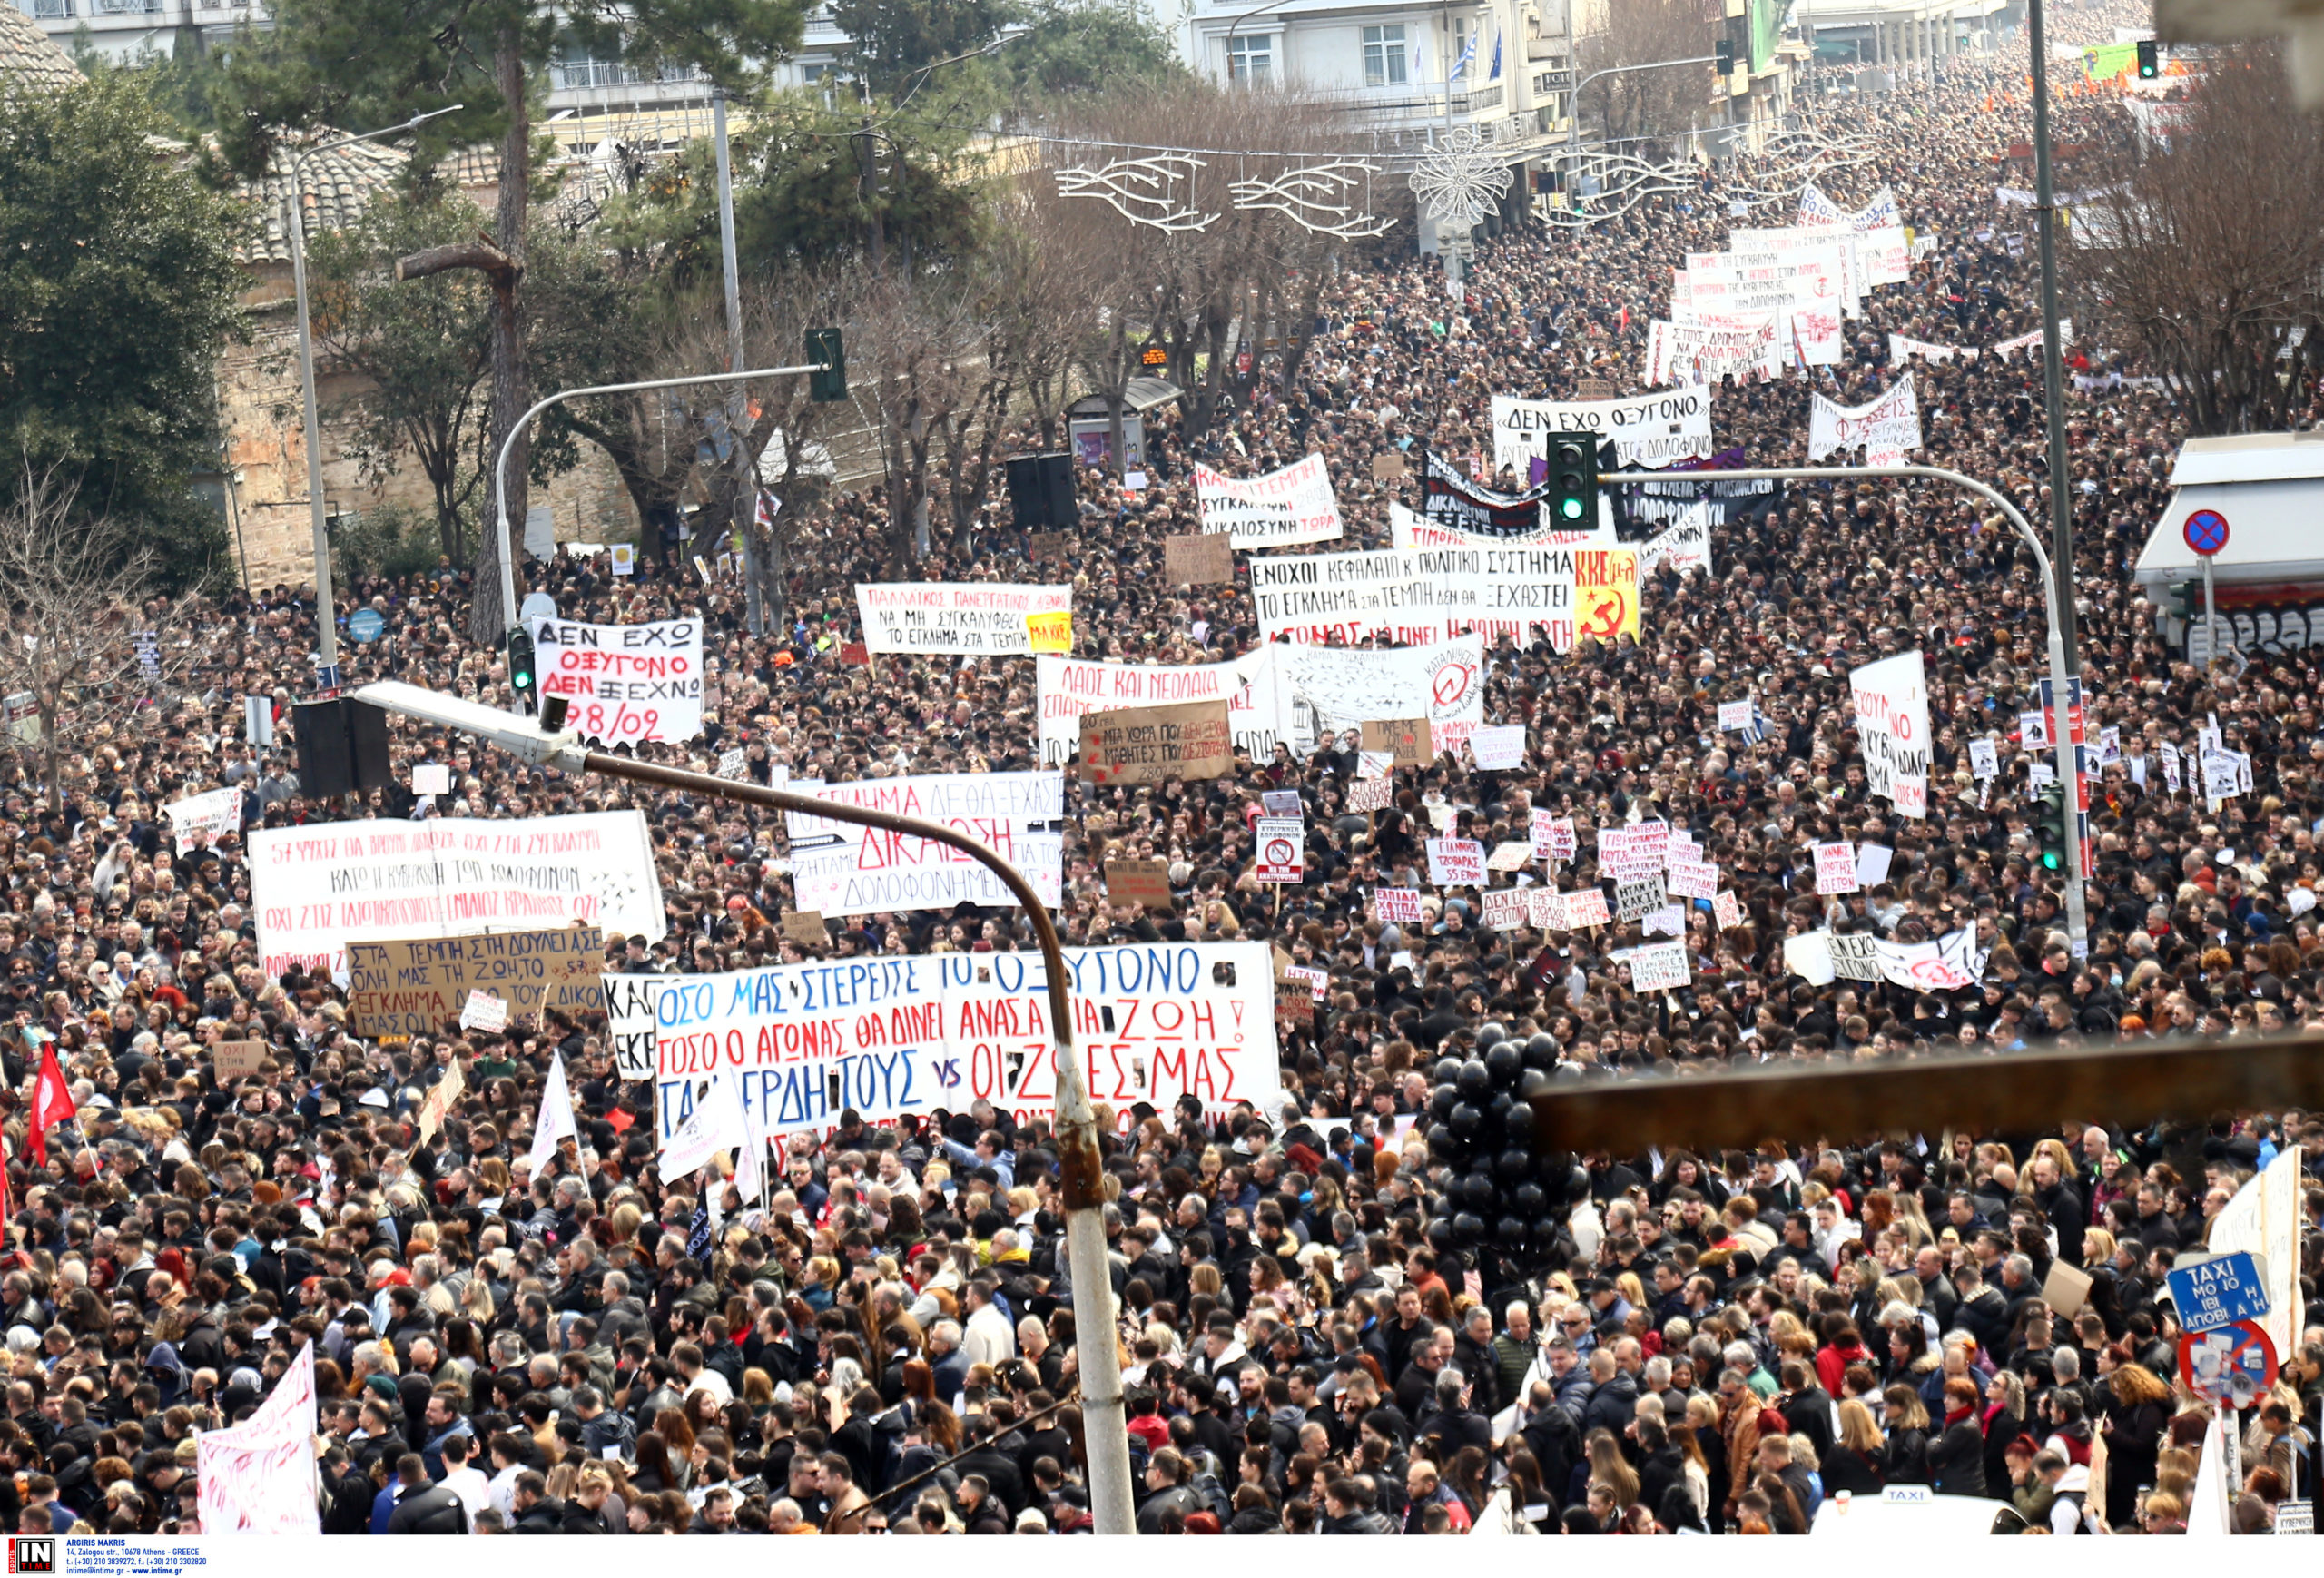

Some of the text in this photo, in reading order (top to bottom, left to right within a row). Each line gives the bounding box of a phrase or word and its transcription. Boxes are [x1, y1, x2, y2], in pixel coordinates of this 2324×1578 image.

[1672, 328, 1705, 343] ΣΤΟΥΣ
[1677, 343, 1690, 355] ΝΑ
[1559, 411, 1600, 432] ΕΧΩ
[1300, 515, 1335, 532] ΤΩΡΑ
[1252, 550, 1573, 587] ΕΝΟΧΟΙ ΚΕΦΑΛΑΙΟ ΠΟΛΙΤΙΚΟ ΣΥΣΤΗΜΑ
[954, 591, 1029, 610] ΠΑΝΕΡΓΑΤΙΚΟΣ
[1259, 594, 1278, 620] ΤΟ
[1285, 590, 1357, 616] ΕΓΚΛΗΜΑ
[1362, 596, 1379, 609] ΣΤΑ
[1382, 582, 1433, 607] ΤΕΜΠΗ
[1462, 590, 1477, 606] ΘΑ
[1487, 585, 1568, 607] ΞΕΧΑΣΤΕΙ
[880, 610, 895, 626] ΝΑ
[905, 610, 925, 626] ΜΗ
[537, 622, 693, 648] ΔΕΝ ΕΧΩ
[887, 628, 1029, 648] ΤΟ ΕΓΚΛΗΜΑ ΣΤΑ ΤΕΜΠΗ
[560, 650, 688, 679] ΟΞΥΓΟΝΟ
[541, 672, 700, 701] ΔΕΝ ΞΕΧΝΩ
[1062, 666, 1107, 696] ΛΑΟΣ
[1115, 671, 1142, 698] ΚΑΙ
[1149, 671, 1218, 700] ΝΕΟΛΑΙΑ
[1104, 724, 1183, 745] ΜΙΑ ΧΩΡΑ ΠΟΥ
[1105, 744, 1182, 765] ΜΑΘΗΤΕΣ ΠΟΥ
[272, 842, 291, 864] 57
[794, 852, 858, 880] ΖΗΤΑΜΕ
[1484, 893, 1508, 909] ΔΕΝ
[265, 906, 292, 932] ΟΧΙ
[1486, 905, 1529, 926] ΟΞΥΓΟΝΟ
[350, 945, 391, 970] ΣΤΑ
[471, 936, 504, 959] ΣΤΗ
[1851, 935, 1876, 958] ΕΧΩ
[351, 969, 388, 992] ΟΛΗ
[398, 966, 432, 986] ΜΑΣ
[438, 964, 464, 984] ΤΗ
[525, 958, 544, 979] ΤΟ
[1288, 968, 1322, 982] ΗΤΑΝ
[355, 991, 447, 1014] ΕΓΚΛΗΜΑ
[657, 982, 714, 1027] ΟΣΟ
[727, 974, 788, 1017] ΜΑΣ
[802, 959, 920, 1011] ΣΤΕΡΕΙΤΕ
[360, 1013, 402, 1035] ΜΑΣ
[657, 998, 1045, 1077] ΤΟΣΟ Ο ΑΓΩΝΑΣ ΘΑ ΔΙΝΕΙ ΑΝΑΣΑ
[659, 1043, 1248, 1139] ΤΑ ΤΟΥΣ ΟΙ ΜΑΣ
[2186, 1259, 2235, 1286] TAXI
[1888, 1491, 1924, 1501] TAXI
